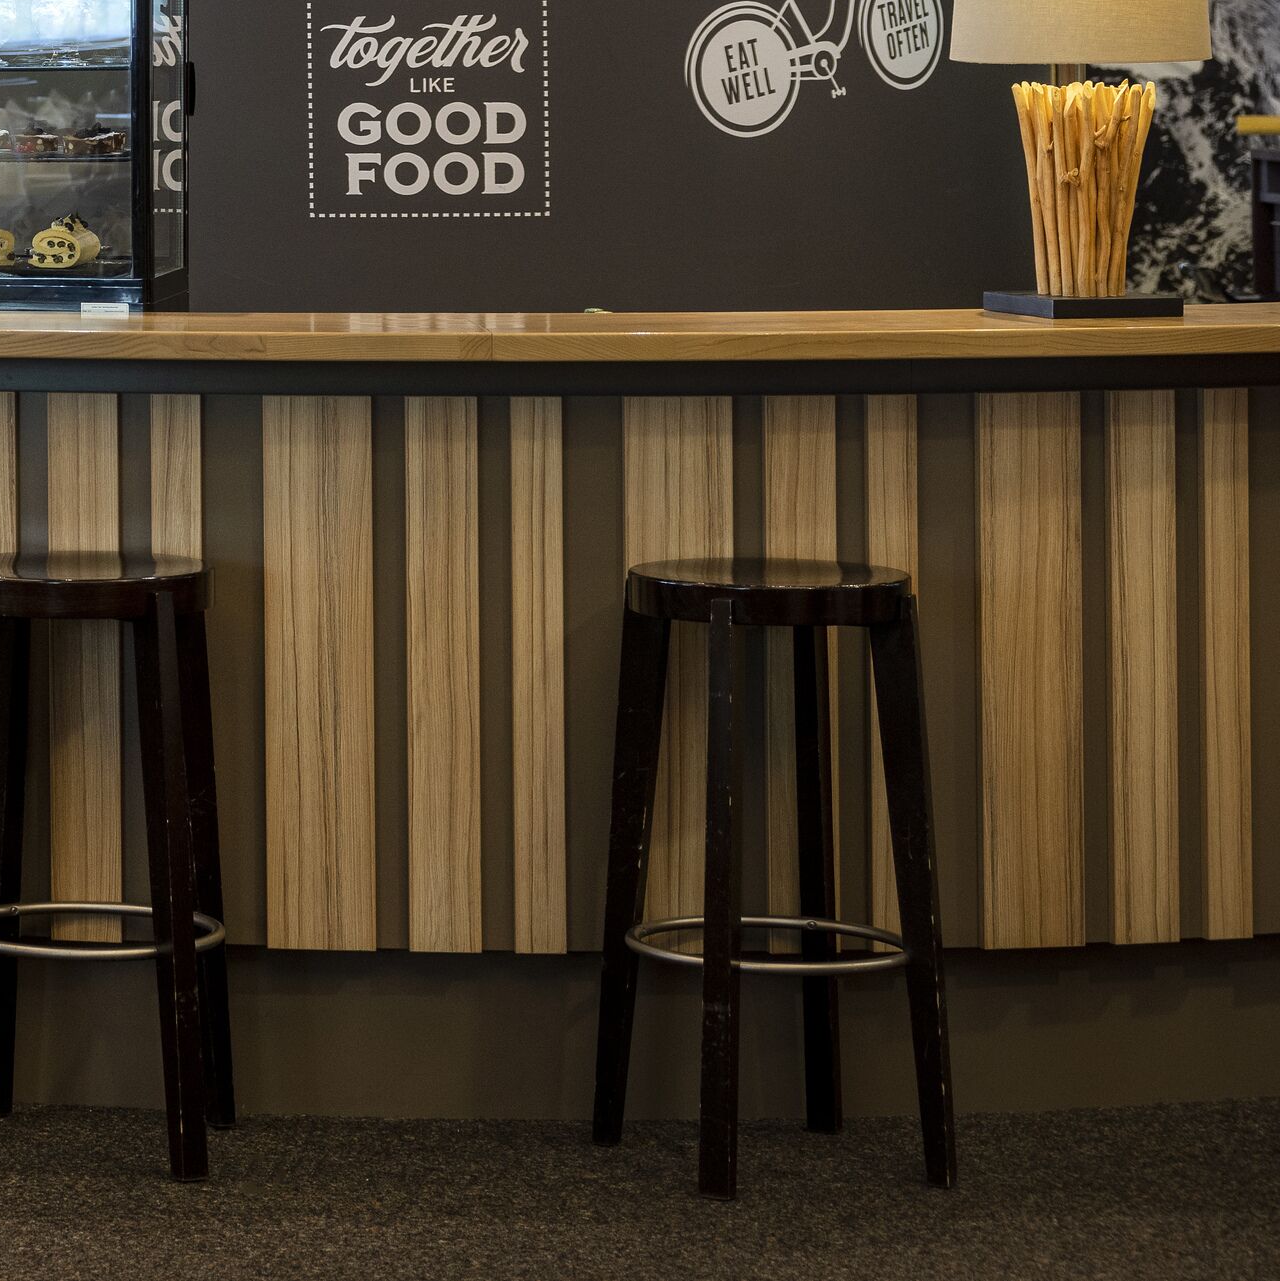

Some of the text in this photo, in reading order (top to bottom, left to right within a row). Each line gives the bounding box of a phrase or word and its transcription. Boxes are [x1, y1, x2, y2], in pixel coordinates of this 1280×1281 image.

[319, 13, 530, 87] together
[724, 38, 759, 73] EAT
[886, 21, 930, 60] OFTEN
[409, 77, 456, 93] LIKE
[721, 67, 776, 105] WELL
[337, 101, 527, 146] GOOD
[345, 151, 525, 196] FOOD
